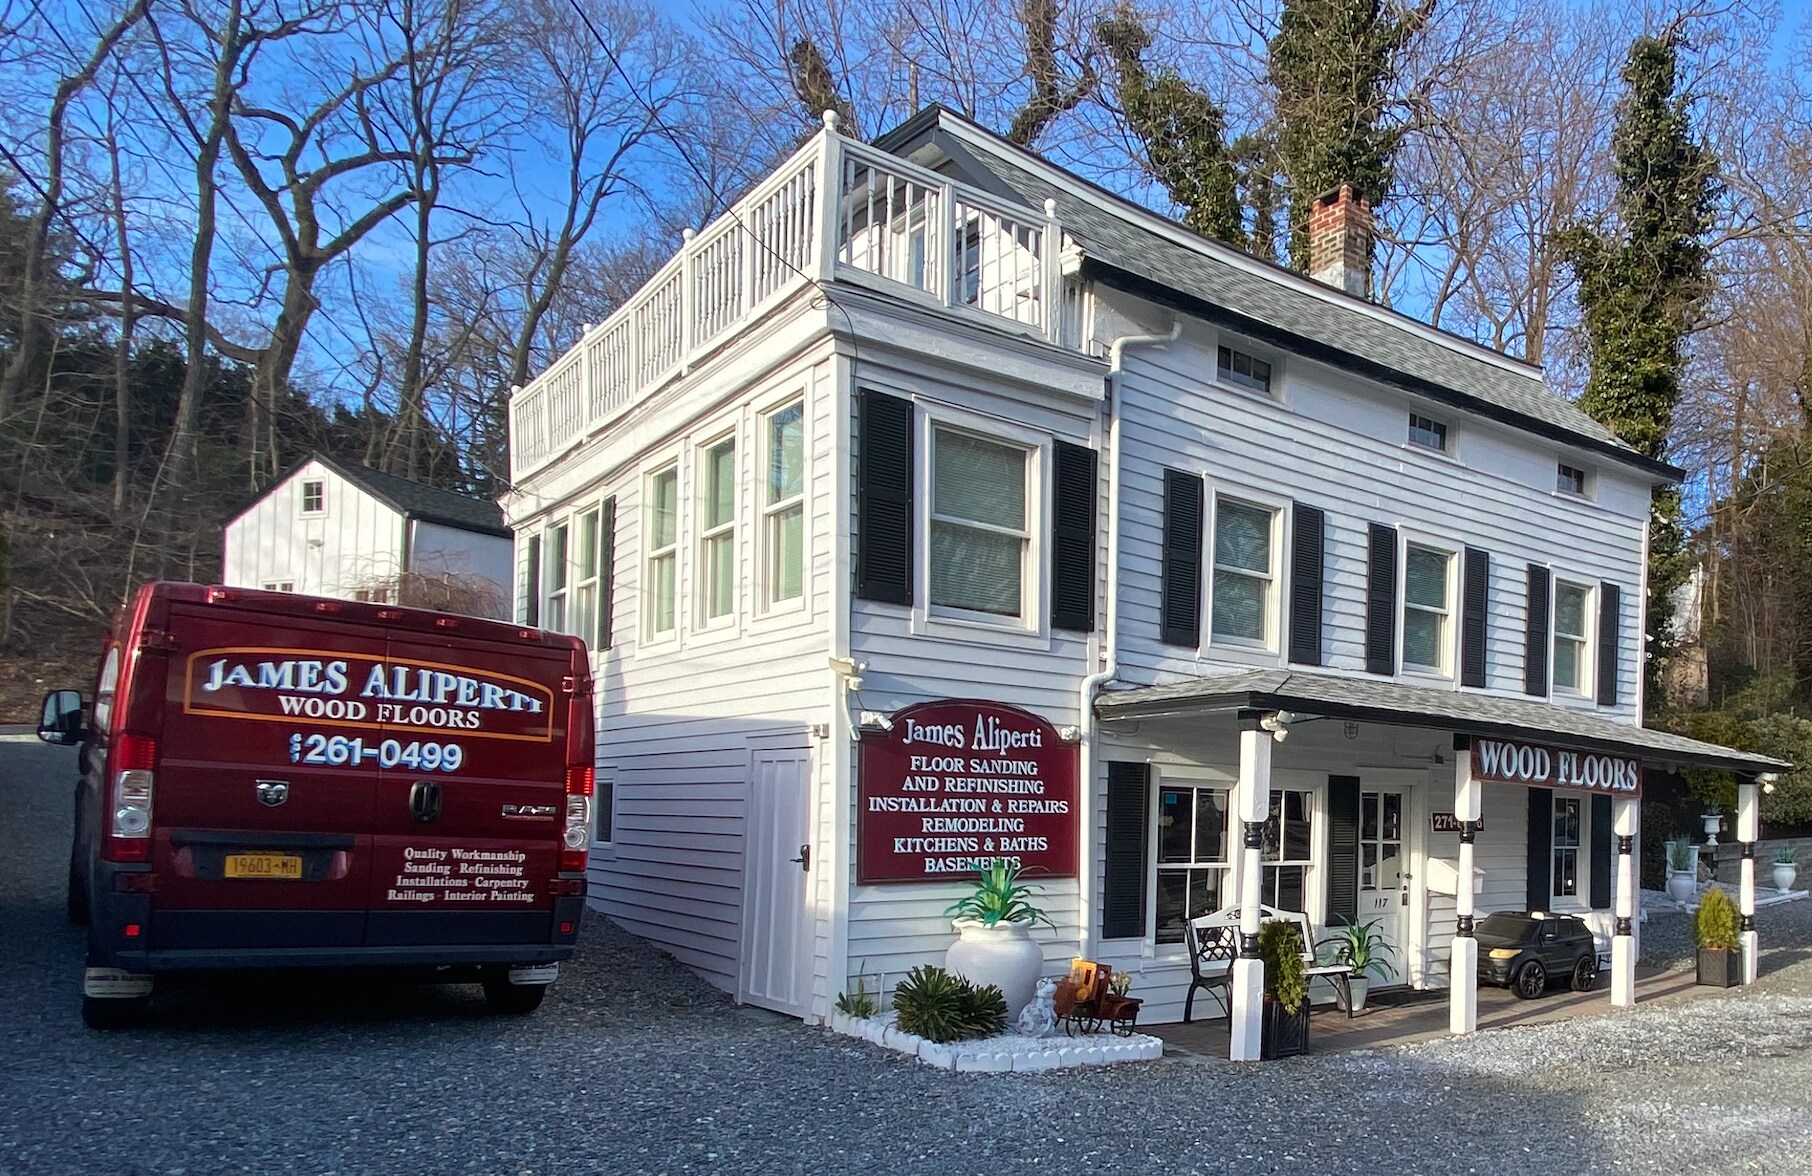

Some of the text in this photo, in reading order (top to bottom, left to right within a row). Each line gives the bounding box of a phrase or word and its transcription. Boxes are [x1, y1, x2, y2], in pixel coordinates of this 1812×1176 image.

[203, 659, 543, 713] JAMES ALIPERTI
[278, 695, 480, 729] WOOD FLOORS
[902, 713, 1043, 756] James Aliperti
[303, 734, 463, 772] 261-0499
[910, 755, 1038, 776] FLOOR SANDING
[1478, 739, 1638, 791] WOOD FLOORS
[902, 776, 1045, 794] AND REFINISHING
[868, 797, 1069, 814] INSTALLATION & REPAIRS
[921, 818, 1024, 832] REMODELING
[893, 837, 1048, 853] KITCHENS & BATHS
[404, 847, 526, 863] Quality Workmanship
[404, 862, 451, 875] Sanding
[459, 862, 523, 876] Refinishing
[396, 875, 468, 887] Installations
[474, 876, 529, 889] Carpentry
[387, 889, 435, 902] Railings
[443, 889, 487, 901] Interior
[490, 890, 535, 903] Painting
[1374, 898, 1389, 909] 117
